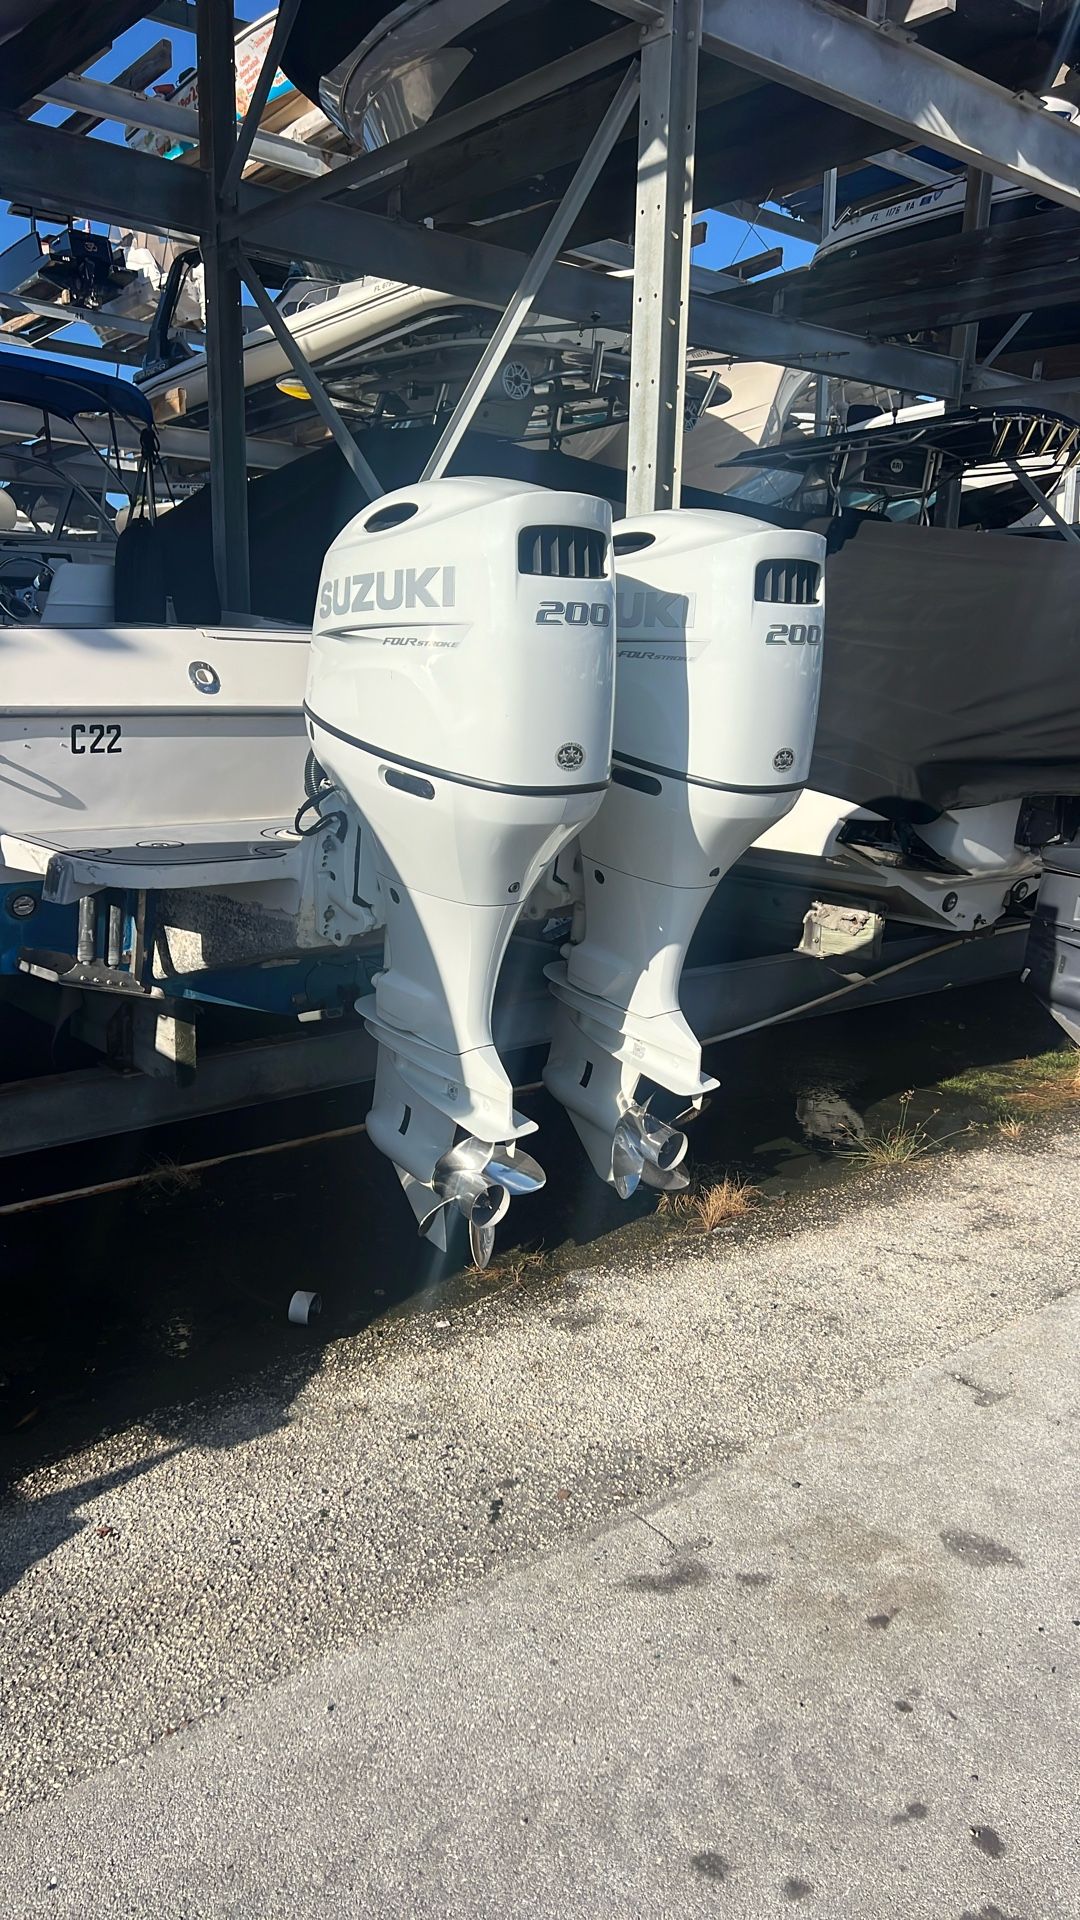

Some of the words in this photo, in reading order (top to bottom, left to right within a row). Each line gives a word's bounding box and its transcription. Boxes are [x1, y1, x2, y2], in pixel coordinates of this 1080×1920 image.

[870, 213, 879, 223] FL
[319, 566, 456, 619] SUZUKI
[535, 601, 611, 627] 200
[765, 624, 821, 646] 200
[71, 724, 122, 754] C22
